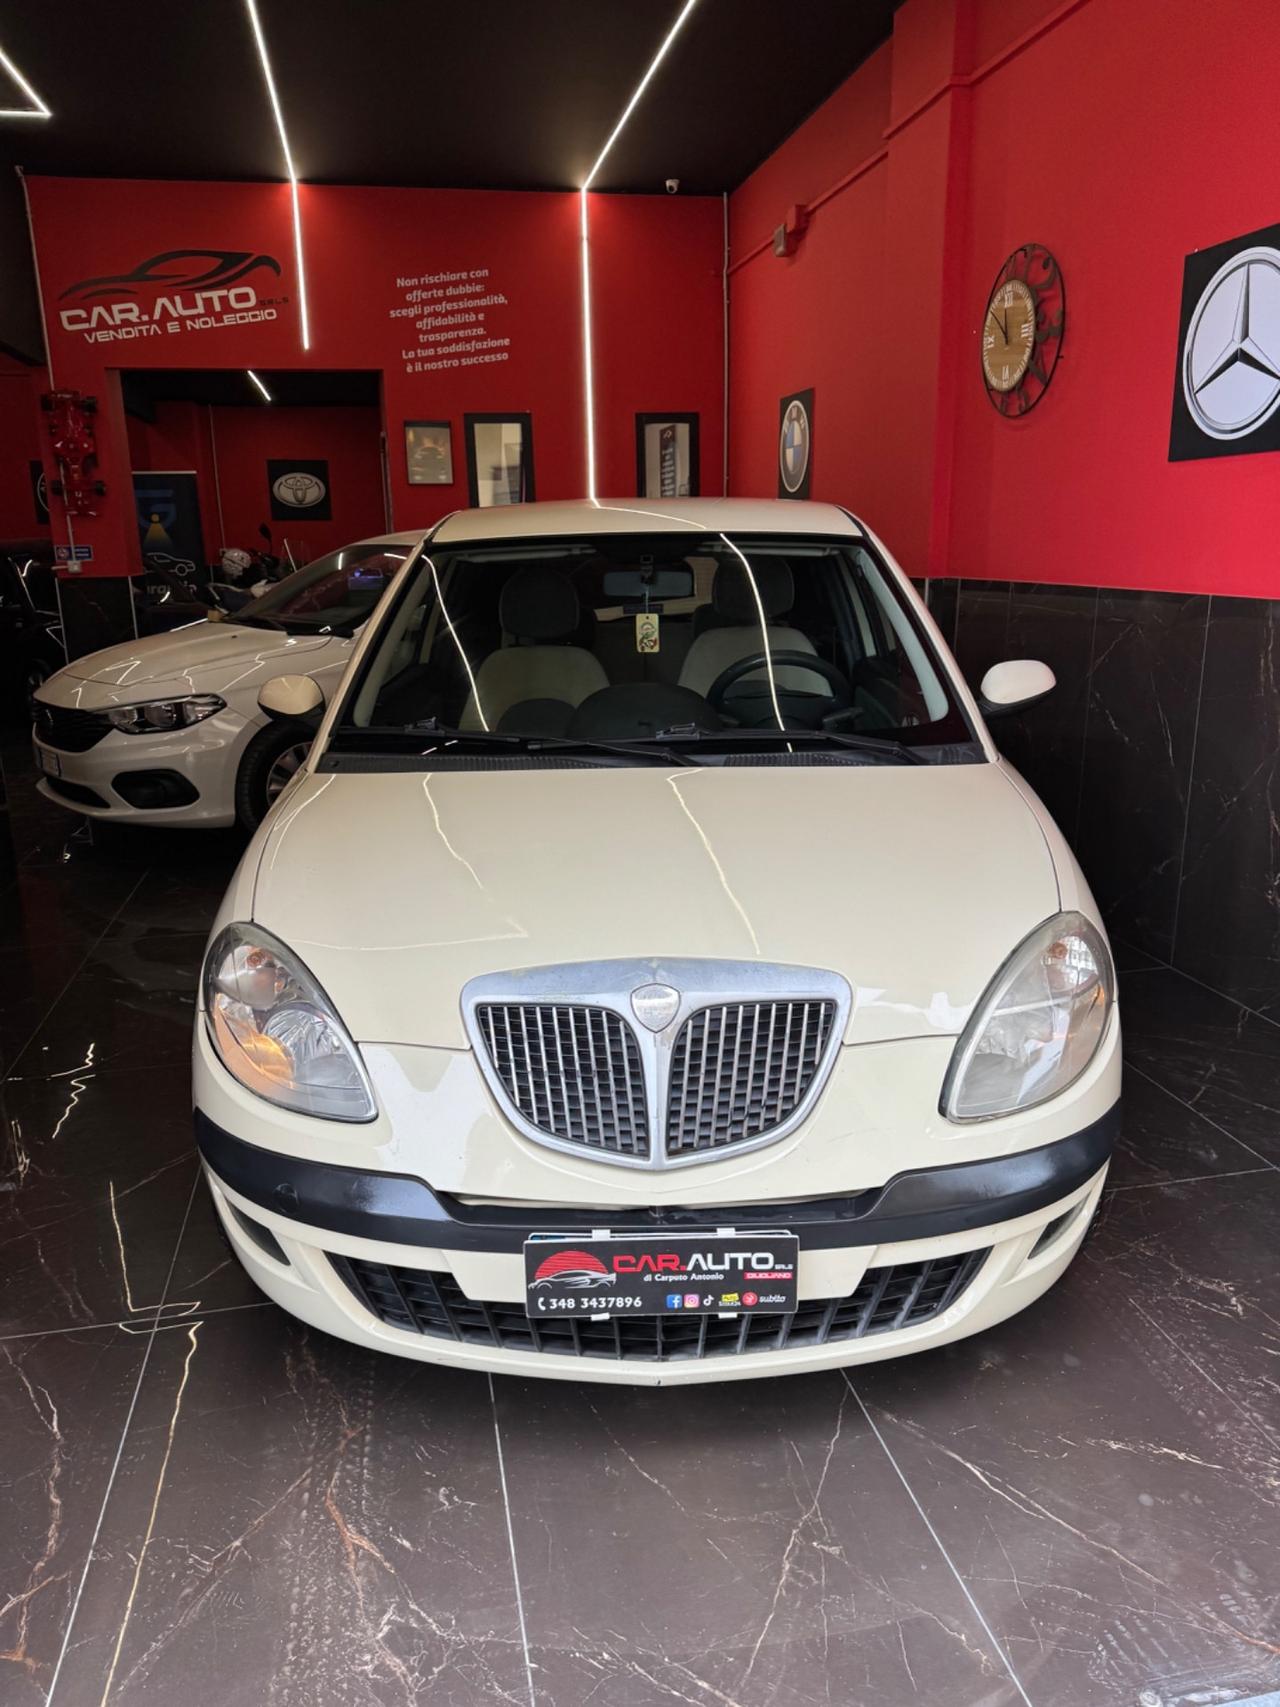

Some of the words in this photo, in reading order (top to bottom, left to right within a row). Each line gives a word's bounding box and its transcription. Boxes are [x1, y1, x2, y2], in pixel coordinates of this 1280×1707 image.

[396, 277, 419, 288] Non
[420, 271, 468, 285] rischiare
[469, 269, 489, 279] con
[405, 288, 444, 303] offerte
[445, 282, 485, 297] dubbie:
[59, 286, 257, 331] CAR.AUTO
[389, 304, 422, 318] scegli
[423, 294, 508, 315] professionalità,
[84, 326, 161, 344] VENDITA
[167, 321, 181, 333] E
[186, 308, 277, 331] NOLEGGIO
[415, 312, 476, 330] affidabilità
[478, 312, 485, 321] e
[418, 327, 487, 343] trasparenza.
[402, 349, 415, 359] La
[417, 347, 435, 358] tua
[436, 338, 511, 355] soddisfazione
[406, 363, 413, 373] è
[415, 362, 422, 372] il
[424, 358, 460, 370] nostro
[461, 352, 509, 366] successo
[613, 1252, 774, 1272] CAR.AUTO
[643, 1273, 652, 1282] di
[654, 1273, 688, 1283] Carputo
[690, 1272, 725, 1281] Antonio
[549, 1297, 576, 1309] 348
[580, 1296, 642, 1308] 3437896
[759, 1294, 786, 1303] subito
